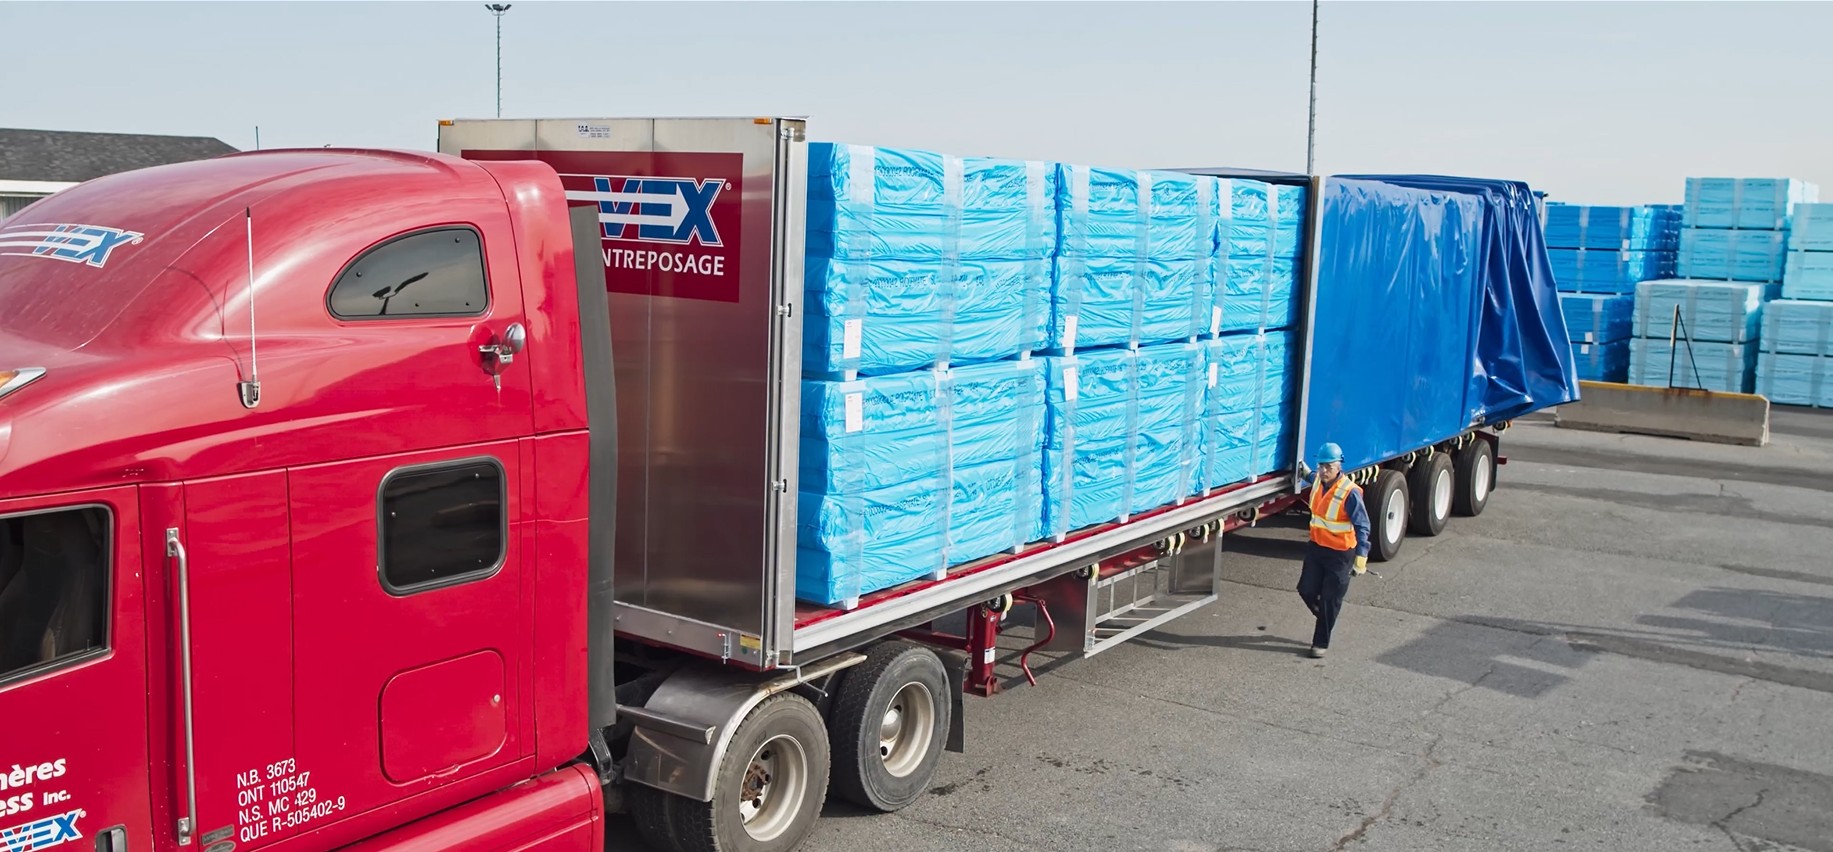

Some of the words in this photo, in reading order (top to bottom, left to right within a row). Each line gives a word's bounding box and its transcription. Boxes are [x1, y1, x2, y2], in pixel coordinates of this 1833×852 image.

[237, 769, 261, 789] N.B.
[266, 758, 296, 779] 3673
[238, 785, 265, 806] ONT
[270, 771, 310, 796] 110547
[43, 789, 71, 806] Inc.
[239, 805, 263, 825] N.S.
[268, 797, 290, 816] MC
[295, 788, 316, 806] 429
[240, 821, 268, 842] QUE
[272, 796, 345, 832] R-505402-9
